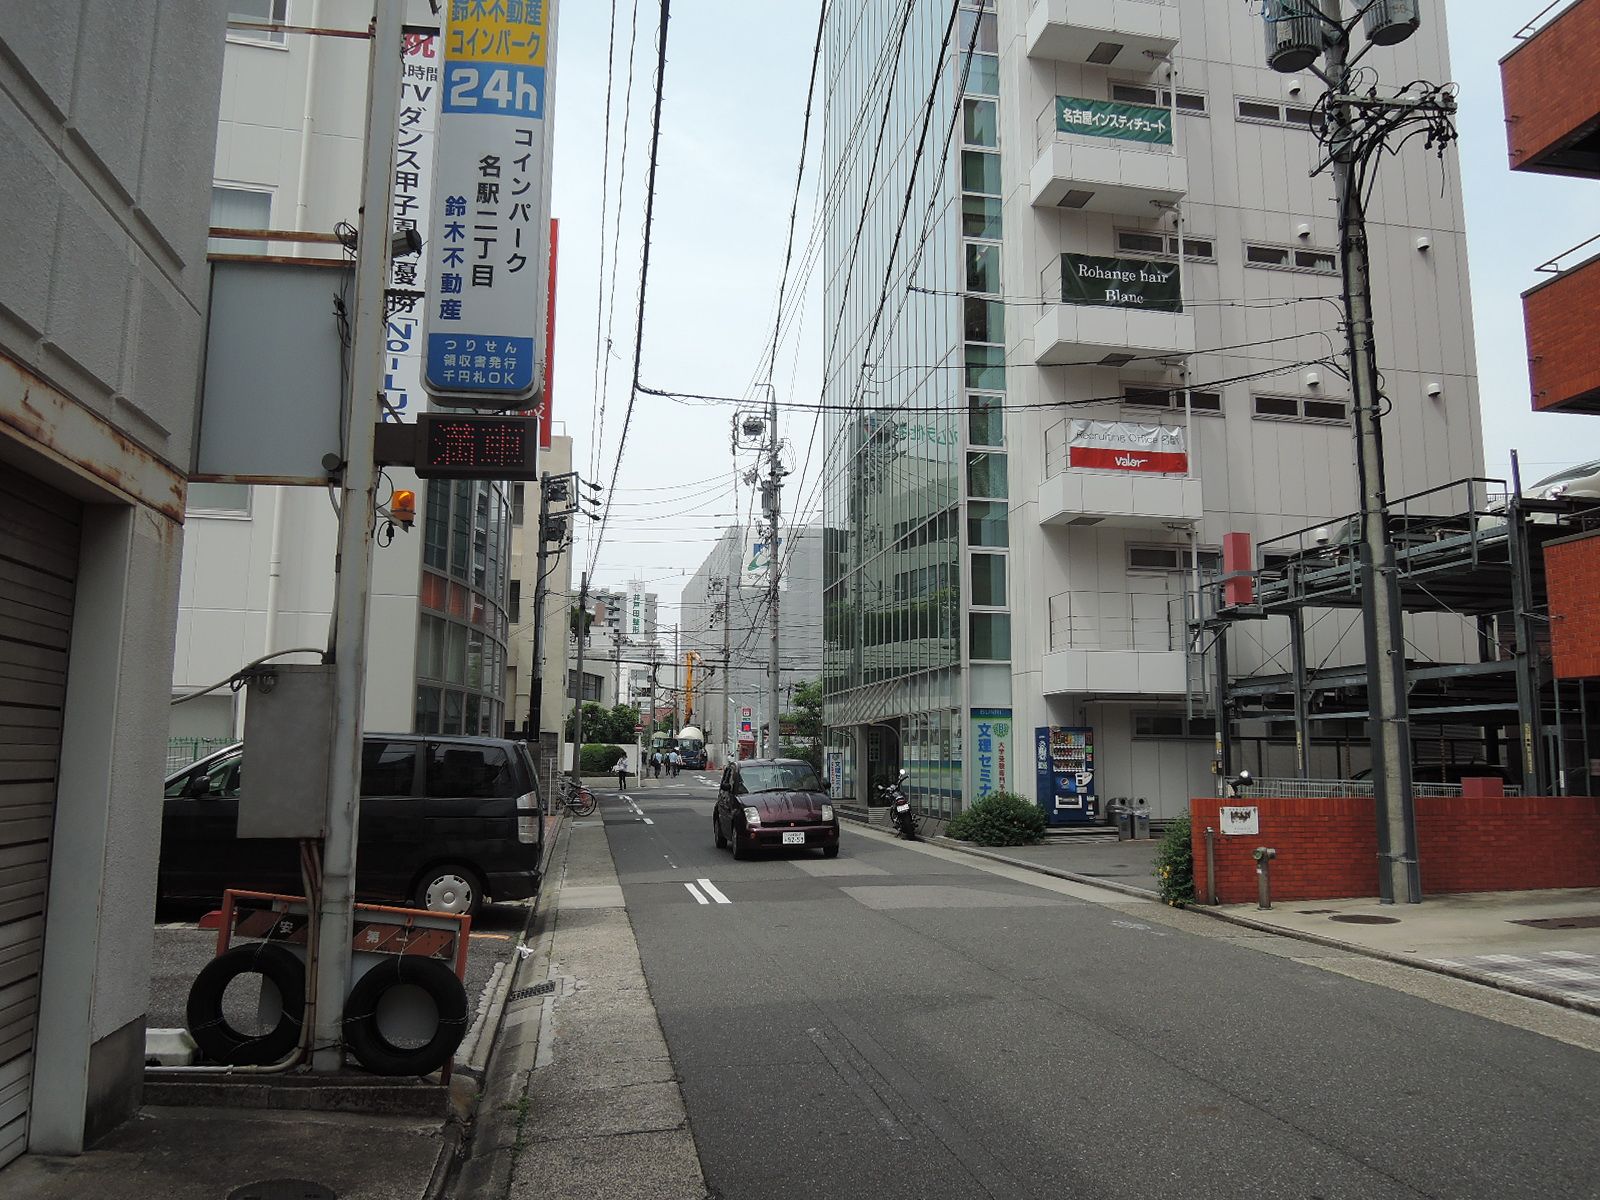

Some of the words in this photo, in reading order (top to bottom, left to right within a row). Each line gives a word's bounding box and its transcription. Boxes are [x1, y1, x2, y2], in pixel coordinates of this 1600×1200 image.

[451, 0, 542, 26] 鈴木不動産
[451, 28, 541, 60] コインパーク
[450, 68, 538, 112] 24h
[1062, 107, 1167, 134] 名古屋インスティチュート
[506, 128, 533, 274] コインパーク
[471, 154, 501, 288] 名駅二丁目
[438, 195, 467, 321] 鈴木不動産
[1078, 263, 1136, 283] Rohange
[1139, 269, 1169, 284] hair
[443, 354, 517, 370] 領収書発行
[444, 339, 517, 354] つりせん
[433, 423, 525, 467] 満車
